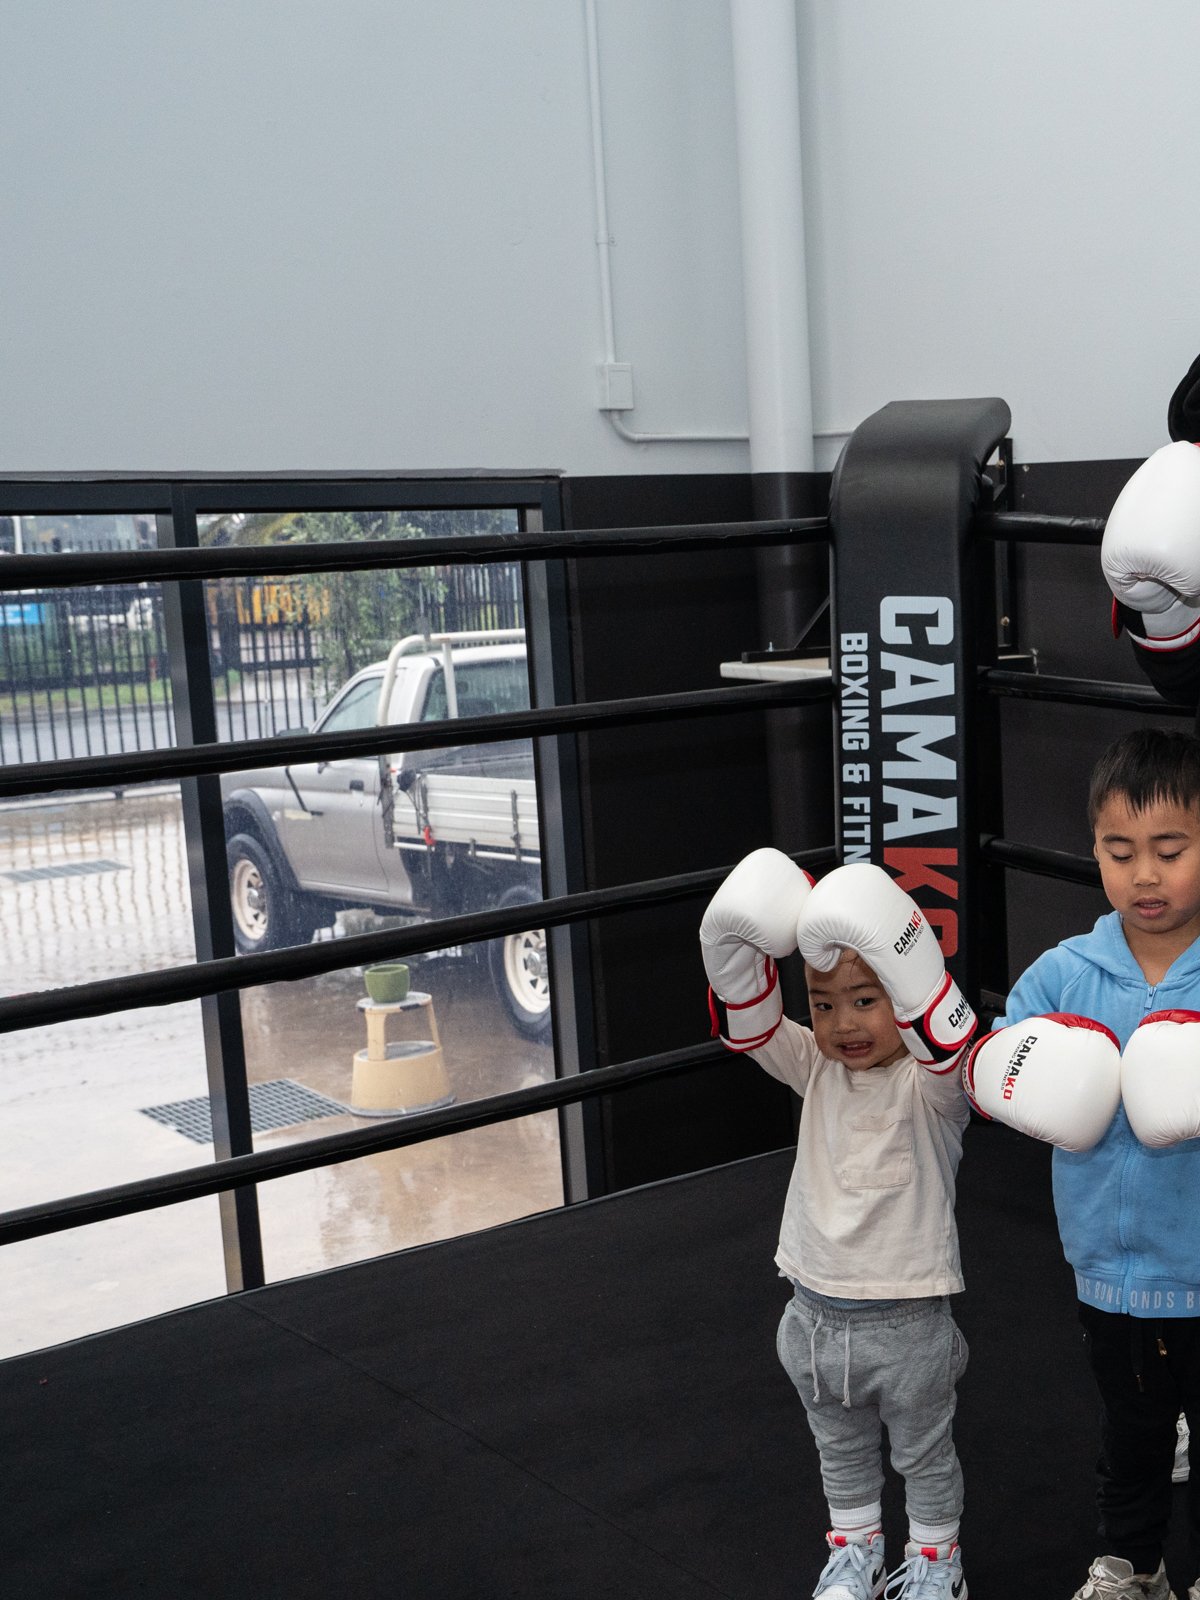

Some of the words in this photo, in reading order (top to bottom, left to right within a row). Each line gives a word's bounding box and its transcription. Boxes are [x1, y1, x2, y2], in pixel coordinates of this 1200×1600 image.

[840, 632, 869, 752] BOXING
[842, 763, 871, 785] &
[843, 797, 871, 864] FITN
[893, 910, 923, 955] CAMAKO
[1003, 1035, 1038, 1101] CAMAKO
[1130, 1291, 1175, 1310] ONDS
